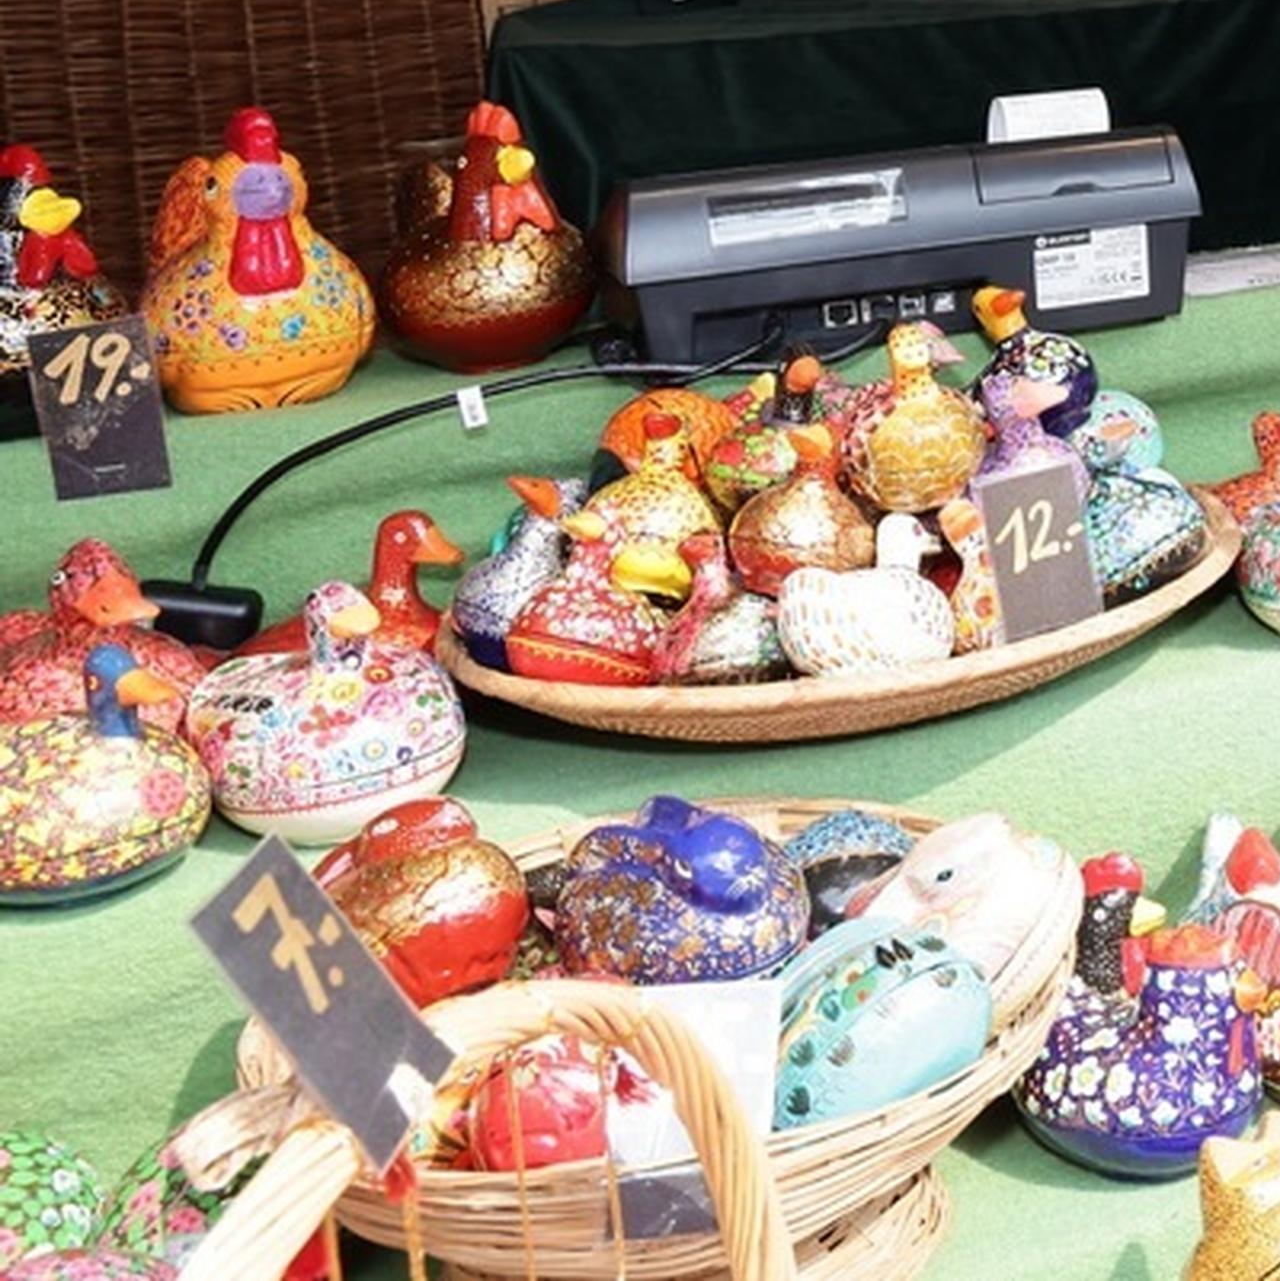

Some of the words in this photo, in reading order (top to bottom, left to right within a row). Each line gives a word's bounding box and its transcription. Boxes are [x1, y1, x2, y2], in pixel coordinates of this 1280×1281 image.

[42, 332, 151, 406] 19.-
[994, 498, 1084, 575] 12.-
[231, 872, 343, 1016] 7.-
